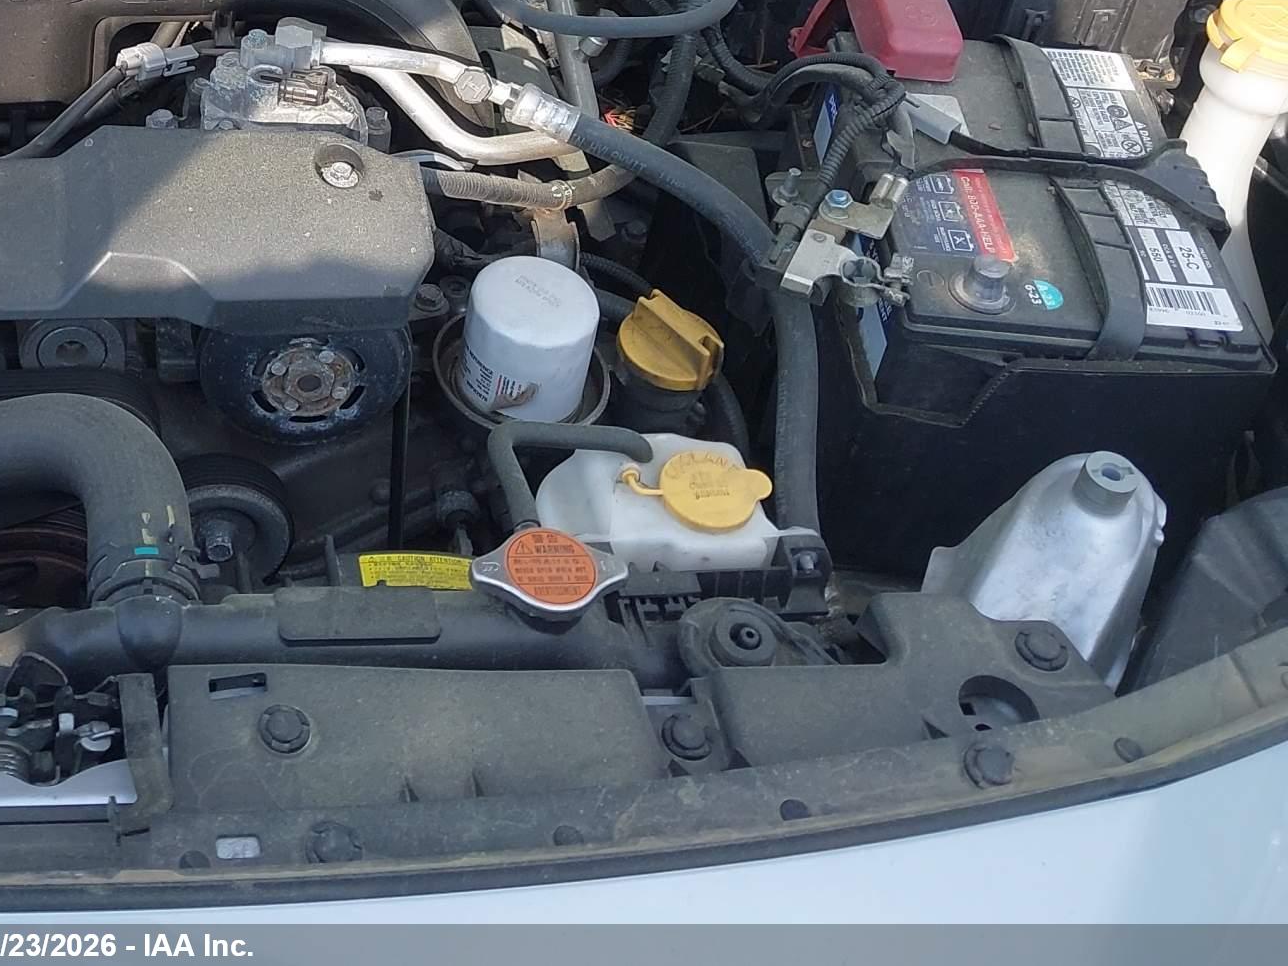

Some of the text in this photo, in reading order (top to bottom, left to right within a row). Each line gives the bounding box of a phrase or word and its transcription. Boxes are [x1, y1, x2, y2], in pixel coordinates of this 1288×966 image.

[1178, 246, 1200, 271] 25-C
[1024, 284, 1042, 305] 6-23
[534, 545, 575, 554] WARNING
